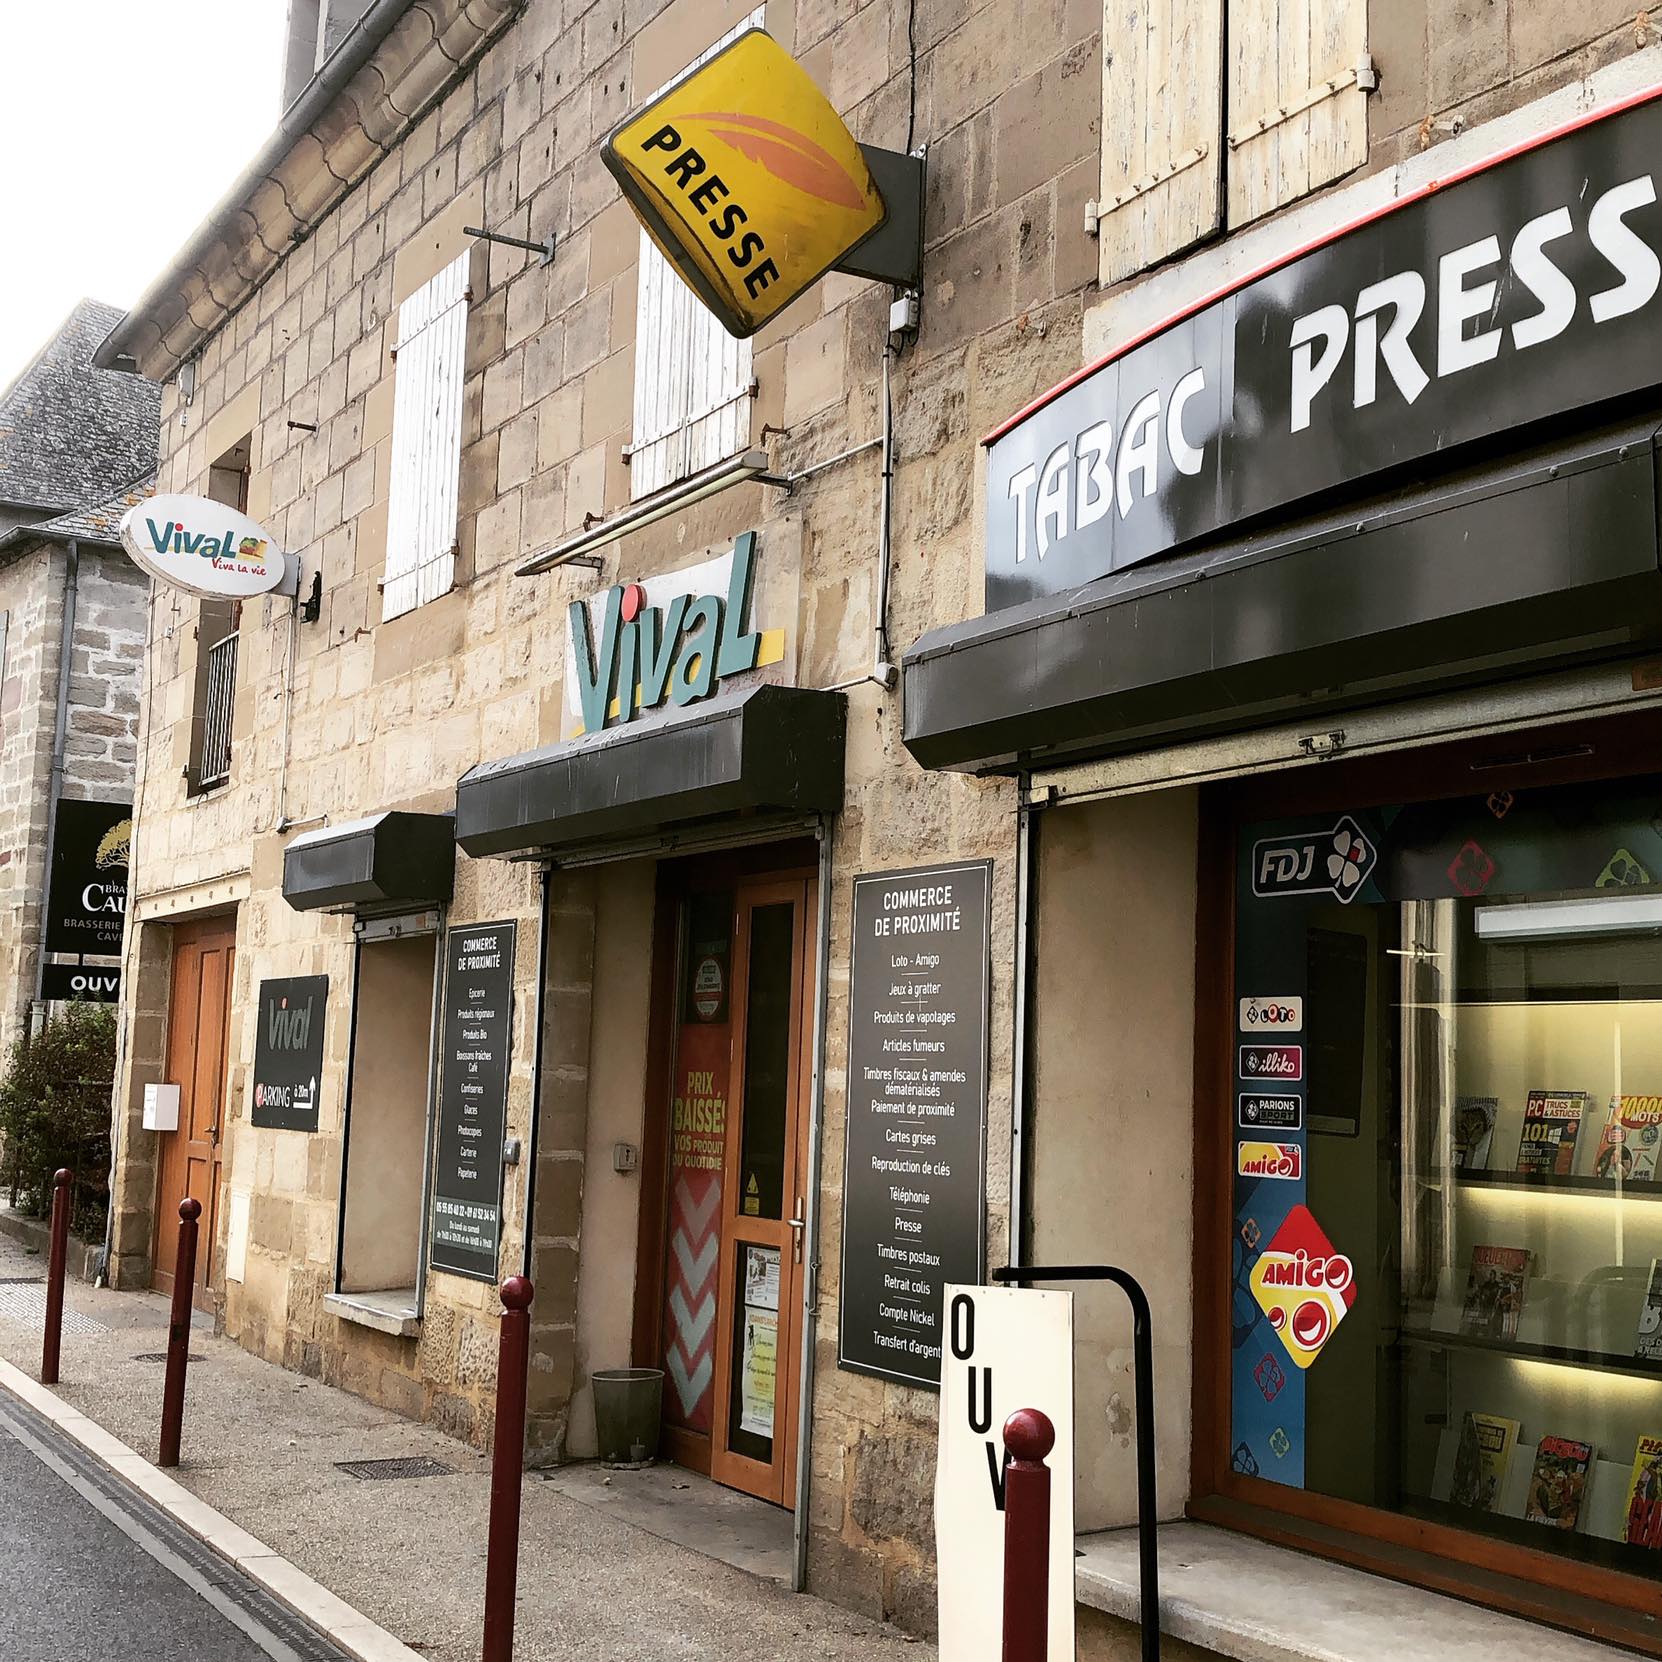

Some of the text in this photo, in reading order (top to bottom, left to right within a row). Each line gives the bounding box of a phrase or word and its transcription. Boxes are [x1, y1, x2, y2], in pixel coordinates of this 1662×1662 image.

[640, 124, 780, 300] PRESSE
[1008, 174, 1662, 564] TABAC PRESS
[212, 558, 234, 572] Viva
[250, 566, 266, 576] vie
[1260, 846, 1315, 883] FDJ
[106, 884, 128, 894] BRA
[883, 886, 952, 910] COMMERCE
[64, 918, 120, 930] BRASSERIE
[874, 906, 960, 937] DE PROXIMITÉ
[462, 936, 498, 952] COMMERCE
[458, 951, 501, 971] DE PROXIMITÉ
[892, 954, 908, 968] Loto
[915, 952, 939, 968] Amigo
[70, 975, 118, 992] OUV
[889, 981, 941, 998] Jeux à gratter
[457, 1009, 474, 1019] Produits
[874, 1010, 956, 1026] Produits de vapotages
[1260, 1004, 1296, 1023] LOTO
[462, 1029, 479, 1040] Produits
[882, 1039, 945, 1052] Articles fumeurs
[456, 1050, 474, 1060] Boissons
[1258, 1052, 1295, 1073] illiko
[468, 1062, 478, 1072] Café
[864, 1067, 966, 1082] Timbres fiscaux & amendes
[461, 1083, 484, 1094] Confiseries
[688, 1072, 714, 1094] PRIX
[884, 1082, 940, 1097] dématérialisés
[256, 1084, 290, 1108] PARKING
[464, 1104, 478, 1115] Glaces
[871, 1100, 955, 1117] Paiement de proximité
[1260, 1100, 1294, 1111] PARIONS
[1527, 1100, 1543, 1117] PC
[1546, 1100, 1568, 1108] TRUCS
[1260, 1111, 1294, 1120] SPORT
[1630, 1111, 1659, 1122] MOTS
[457, 1124, 482, 1137] Photocopies
[886, 1129, 936, 1146] Cartes grises
[1522, 1124, 1549, 1142] 101
[460, 1146, 477, 1158] Carterie
[674, 1134, 724, 1154] VOS PRODUIT
[685, 1155, 722, 1170] QUOTIDIE
[872, 1156, 950, 1176] Reproduction de clés
[457, 1167, 477, 1180] Papeterie
[890, 1186, 930, 1205] Téléphonie
[895, 1216, 922, 1233] Presse
[877, 1243, 940, 1266] Timbres postaux
[884, 1274, 930, 1295] Retrait colis
[879, 1303, 935, 1327] Compte Nickel
[873, 1331, 941, 1359] Transfert d'argent
